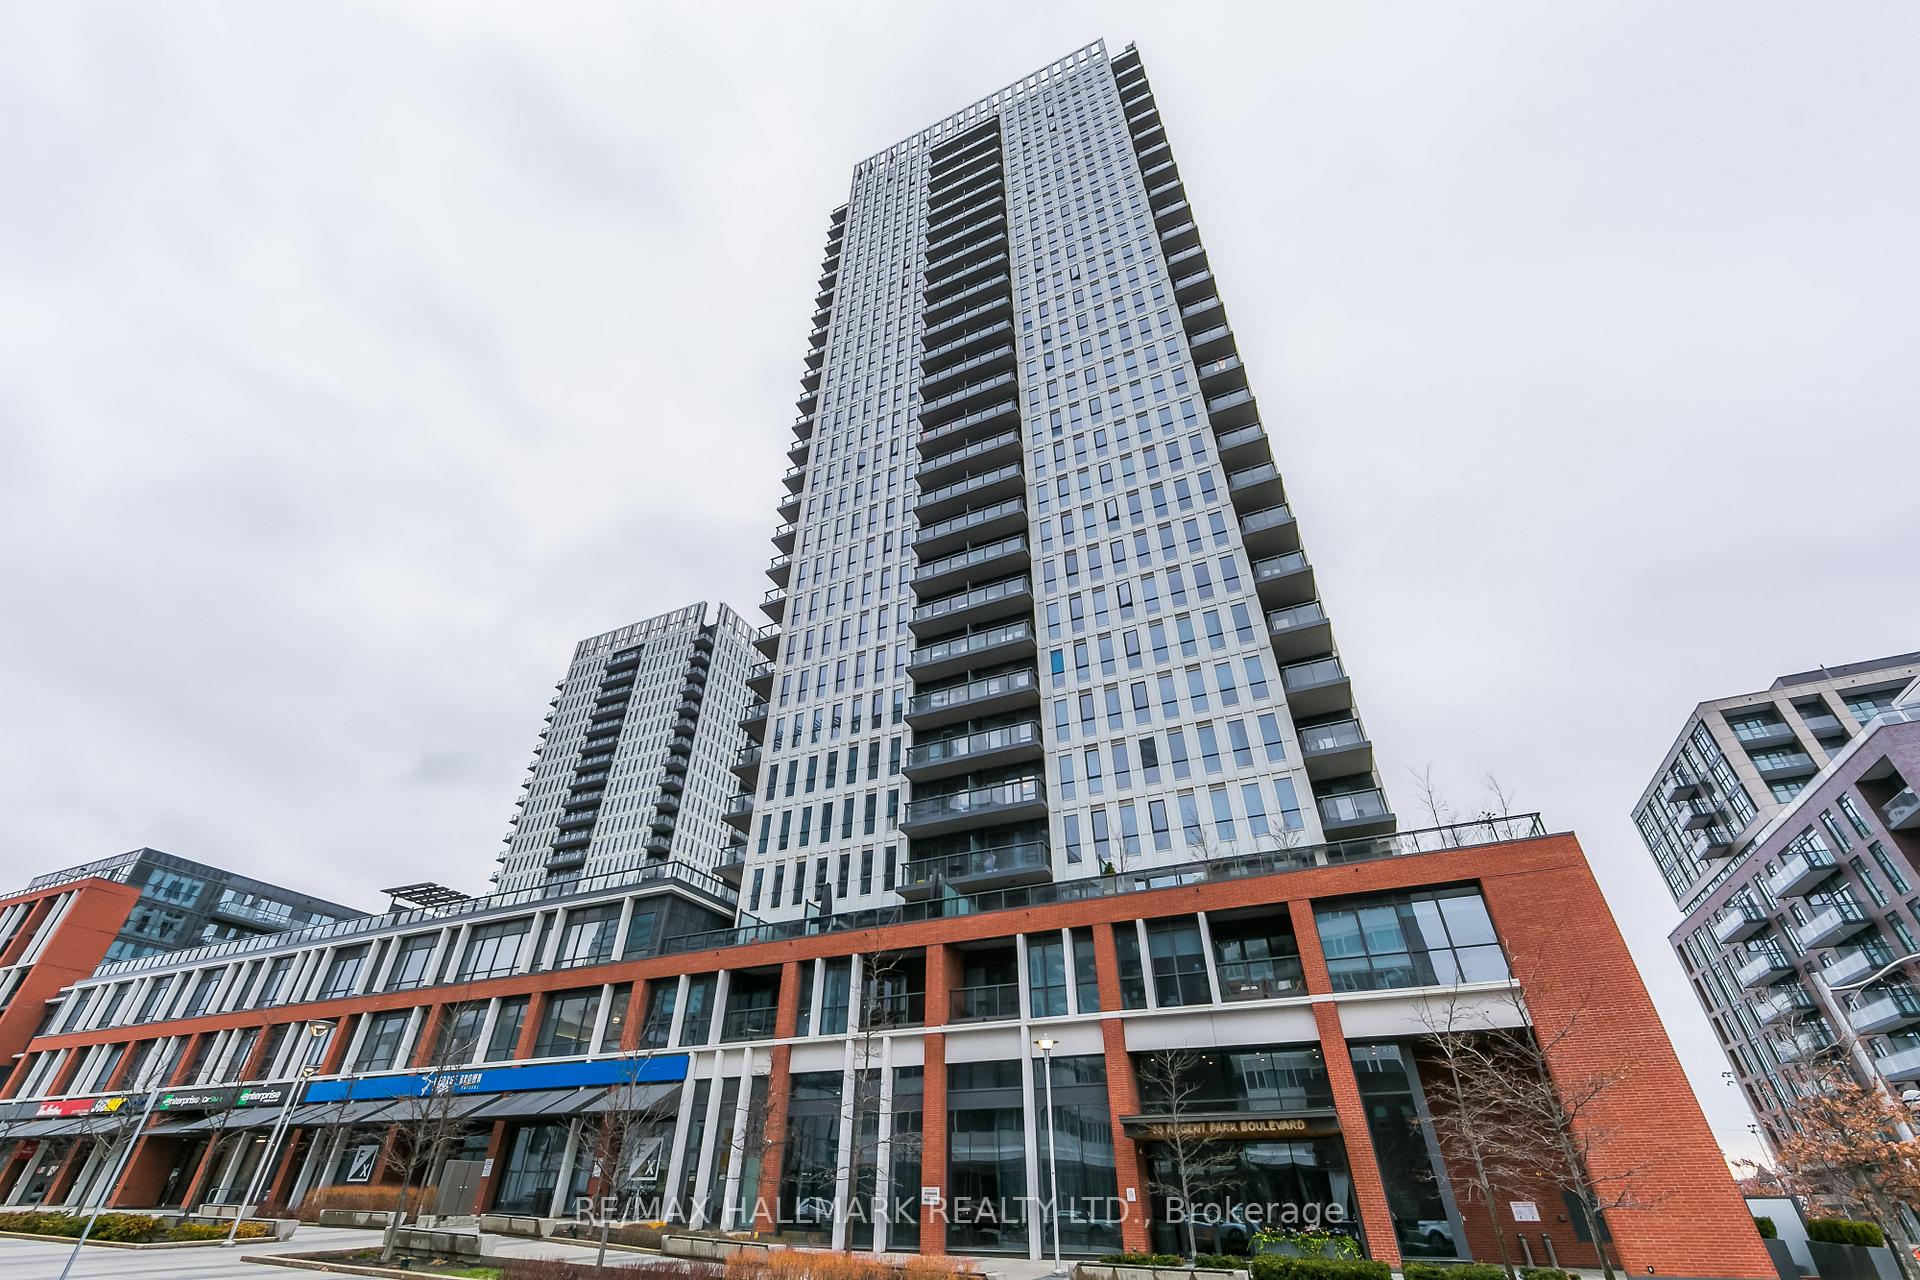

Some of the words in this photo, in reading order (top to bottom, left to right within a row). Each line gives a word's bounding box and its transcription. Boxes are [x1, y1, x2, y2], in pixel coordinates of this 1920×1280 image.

[162, 1094, 200, 1107] enterprise
[240, 1090, 282, 1104] enterprise
[1166, 1123, 1206, 1135] RGENT
[1209, 1122, 1238, 1133] PARK
[1240, 1119, 1305, 1132] BOULEVARD
[356, 1151, 364, 1162] F
[359, 1164, 369, 1177] X
